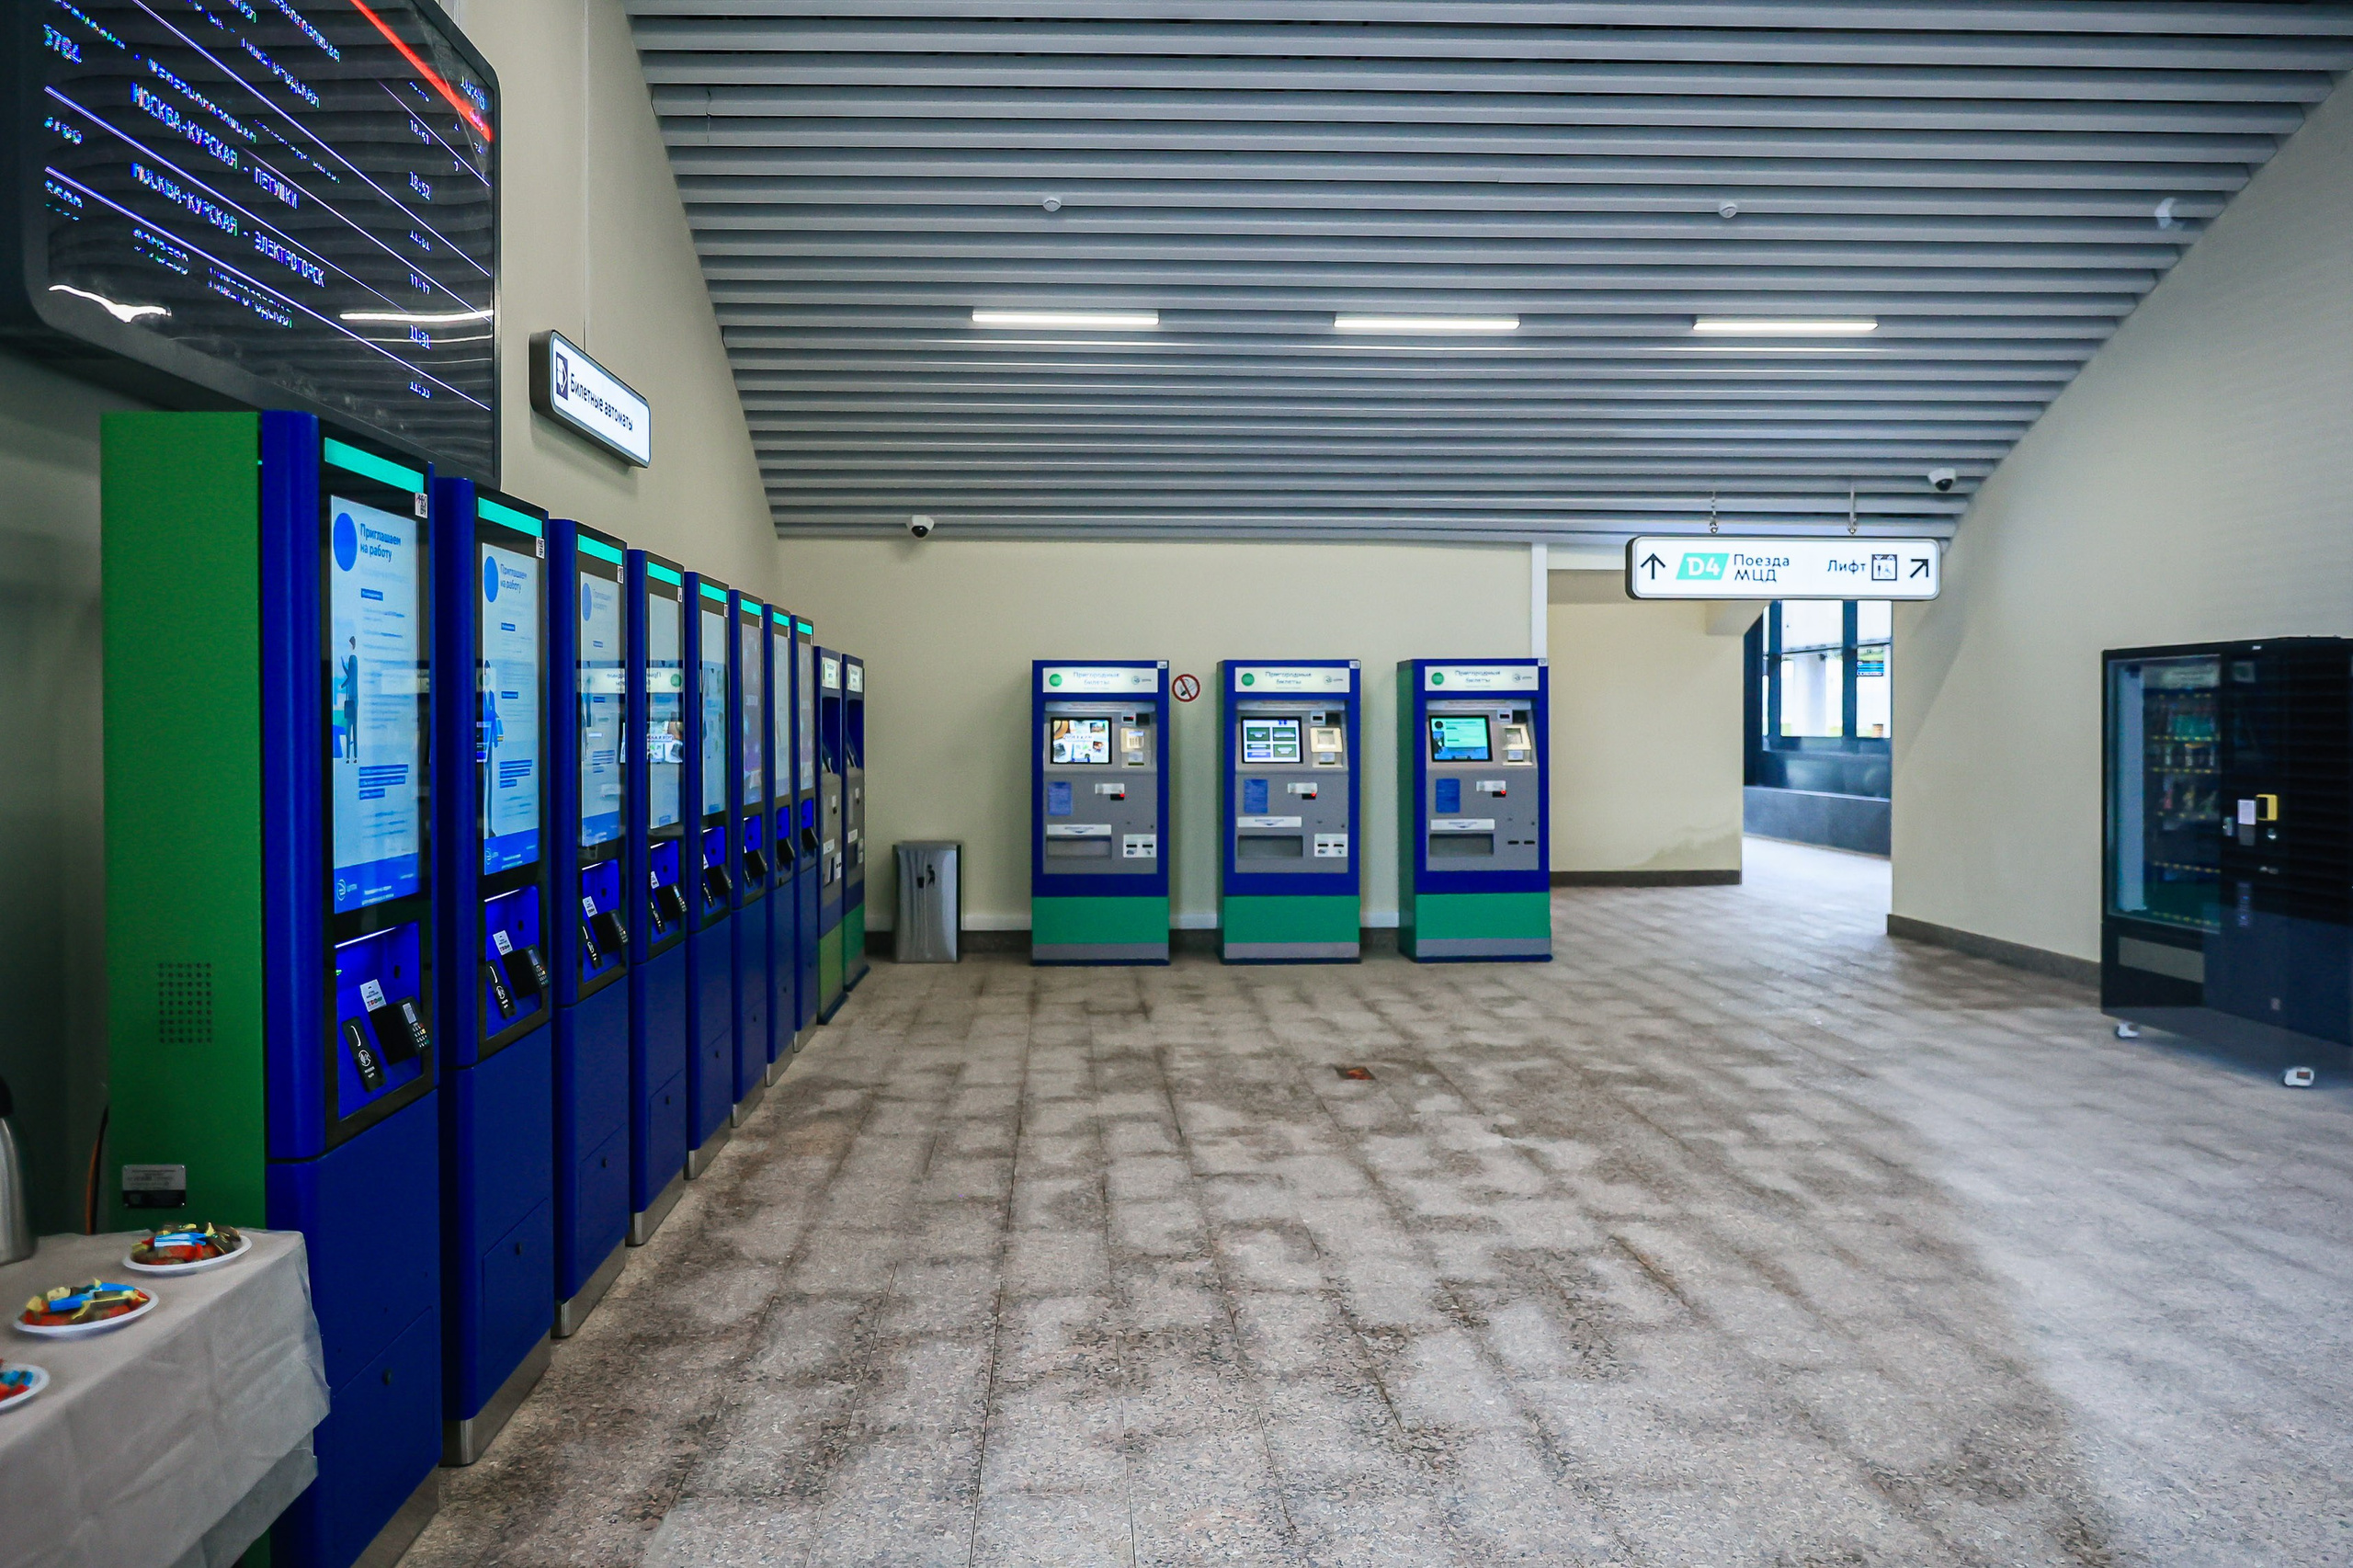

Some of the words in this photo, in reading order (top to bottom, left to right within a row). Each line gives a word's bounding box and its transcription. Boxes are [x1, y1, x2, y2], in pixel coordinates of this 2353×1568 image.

[131, 82, 238, 170] МОСКВА-КУРСКАЯ
[254, 166, 300, 210] ПЕТУШКИ
[254, 230, 325, 288] ЭЛЕКТРОГОРСК
[570, 372, 603, 413] Билетные
[604, 402, 633, 432] автоматы
[360, 523, 402, 546] Приглашаем
[359, 543, 369, 554] на
[369, 544, 392, 562] работу
[1733, 553, 1790, 568] Поезда
[1686, 556, 1721, 576] D4
[1734, 569, 1777, 583] МЦД
[1827, 560, 1866, 575] Лифт
